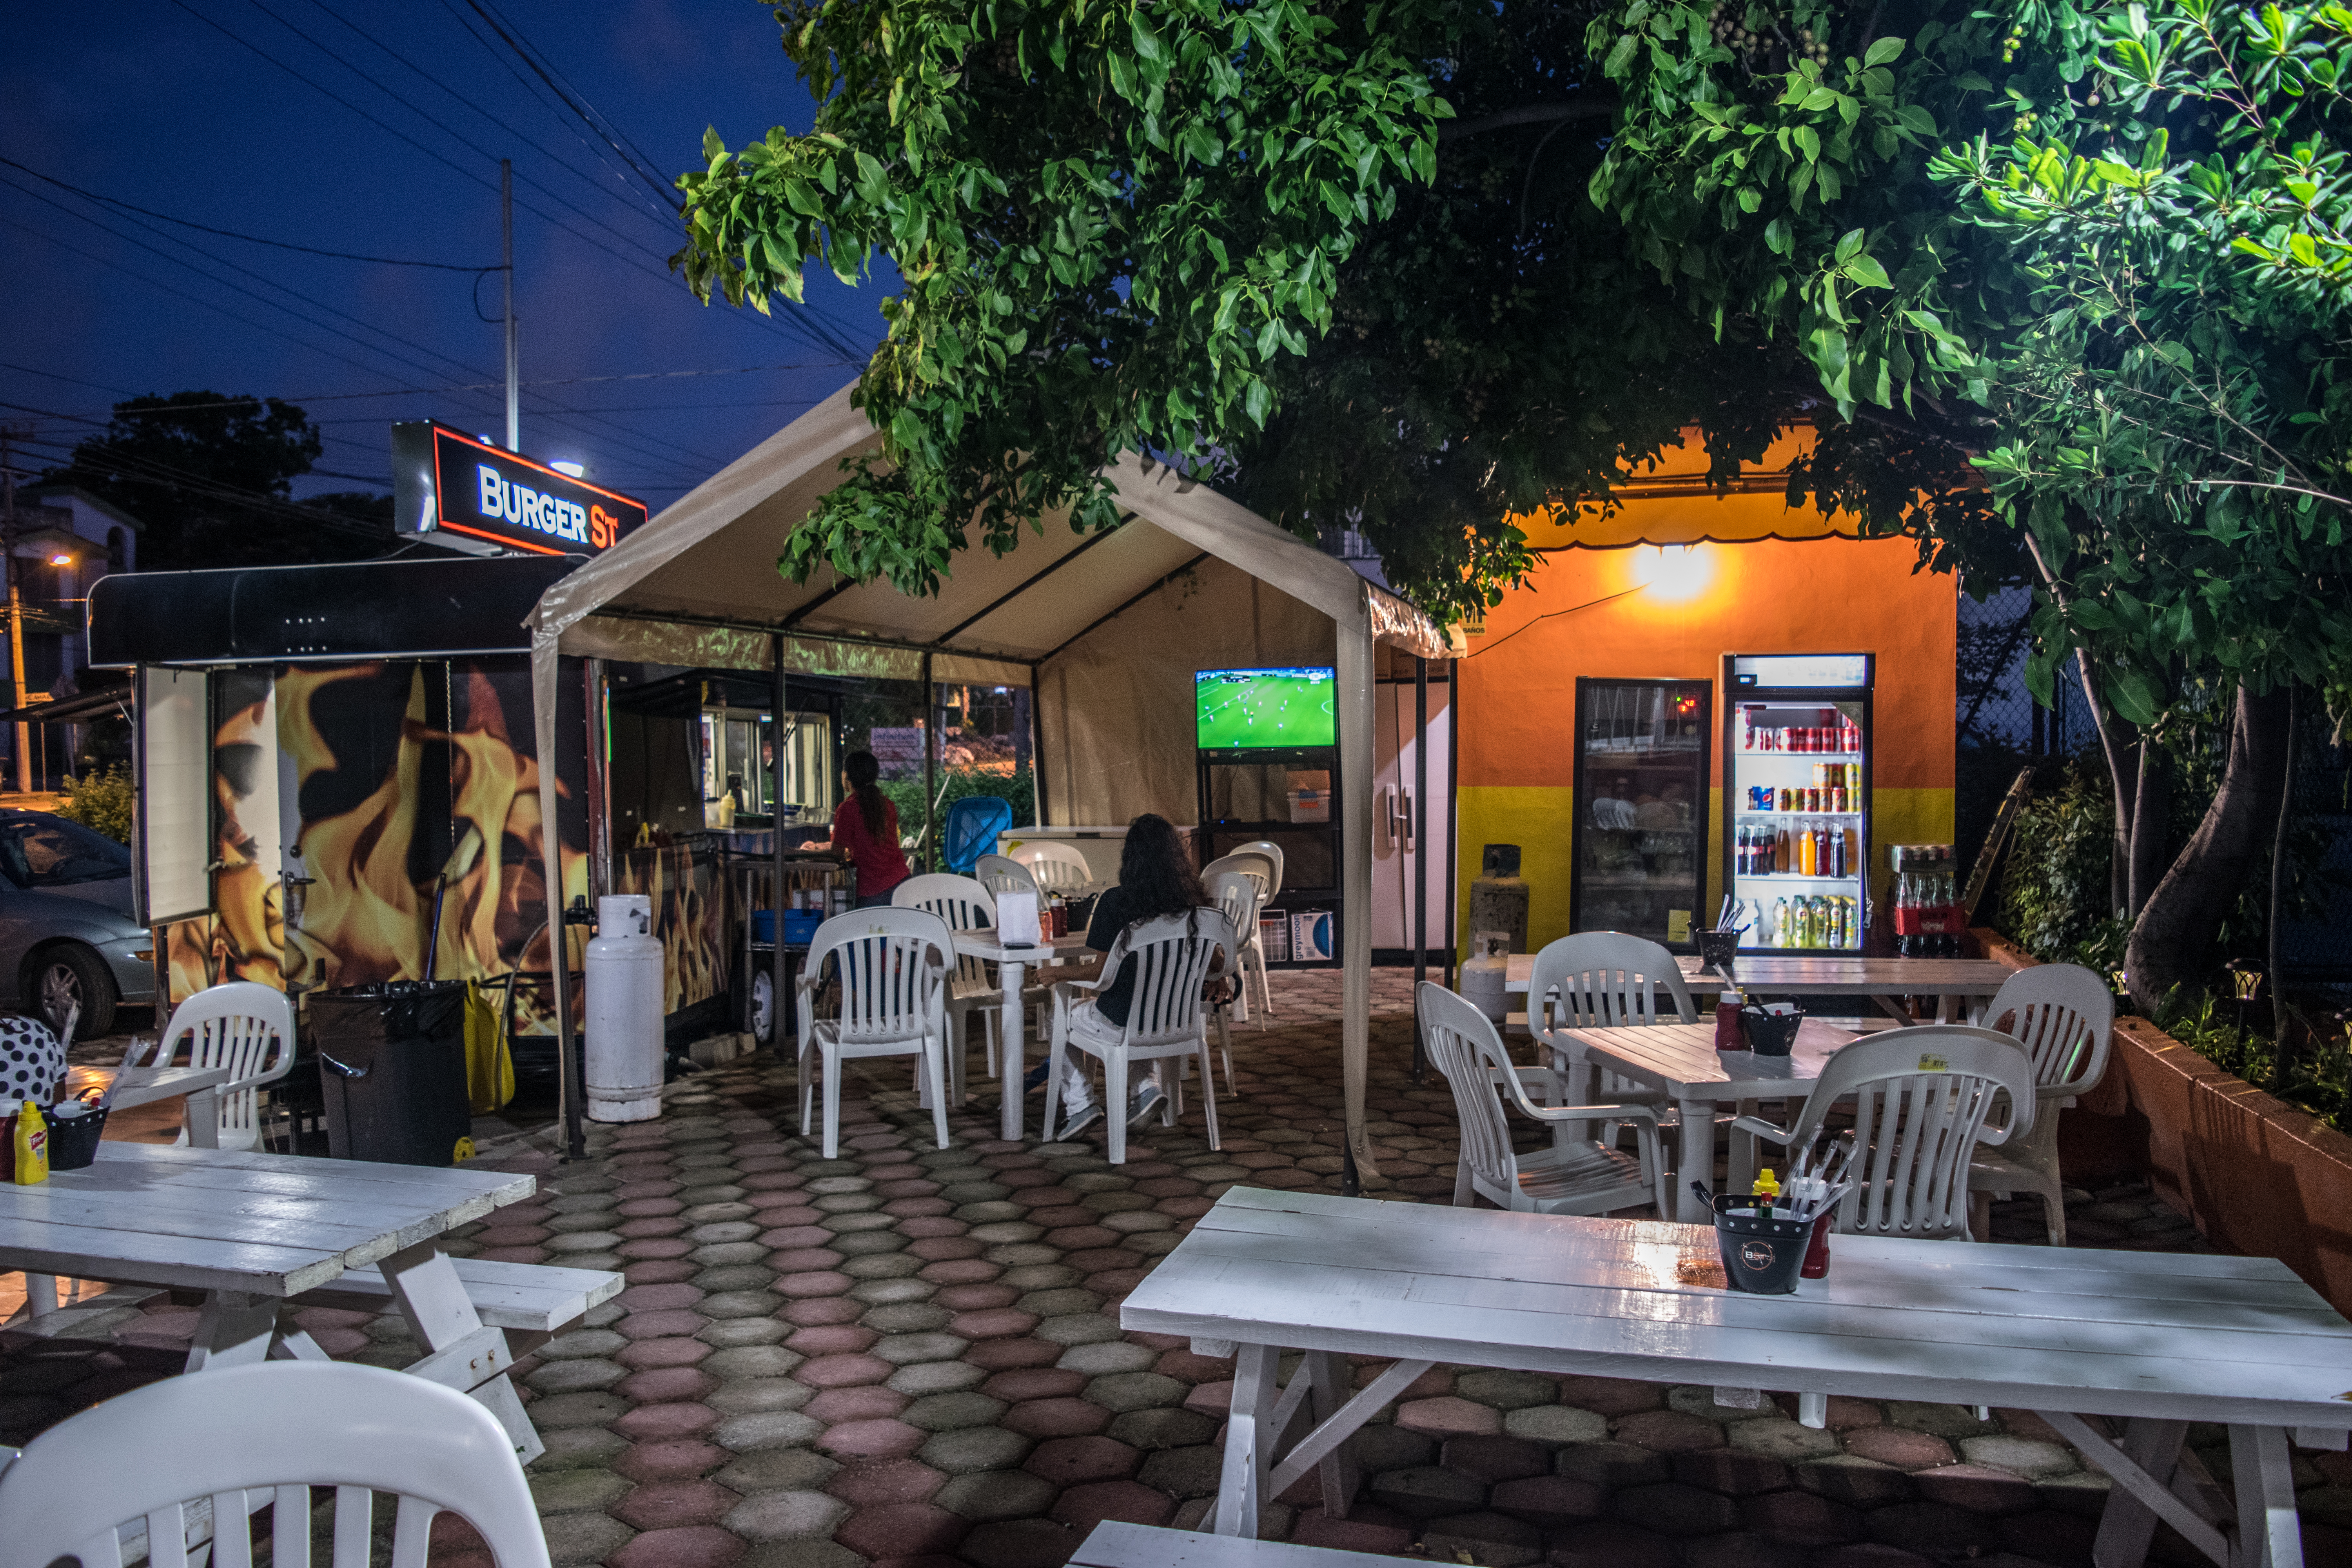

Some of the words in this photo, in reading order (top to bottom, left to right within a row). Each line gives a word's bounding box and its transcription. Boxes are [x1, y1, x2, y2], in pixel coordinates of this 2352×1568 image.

[479, 465, 589, 544] BURGER
[590, 504, 619, 548] ST
[1294, 915, 1304, 960] greymoon
